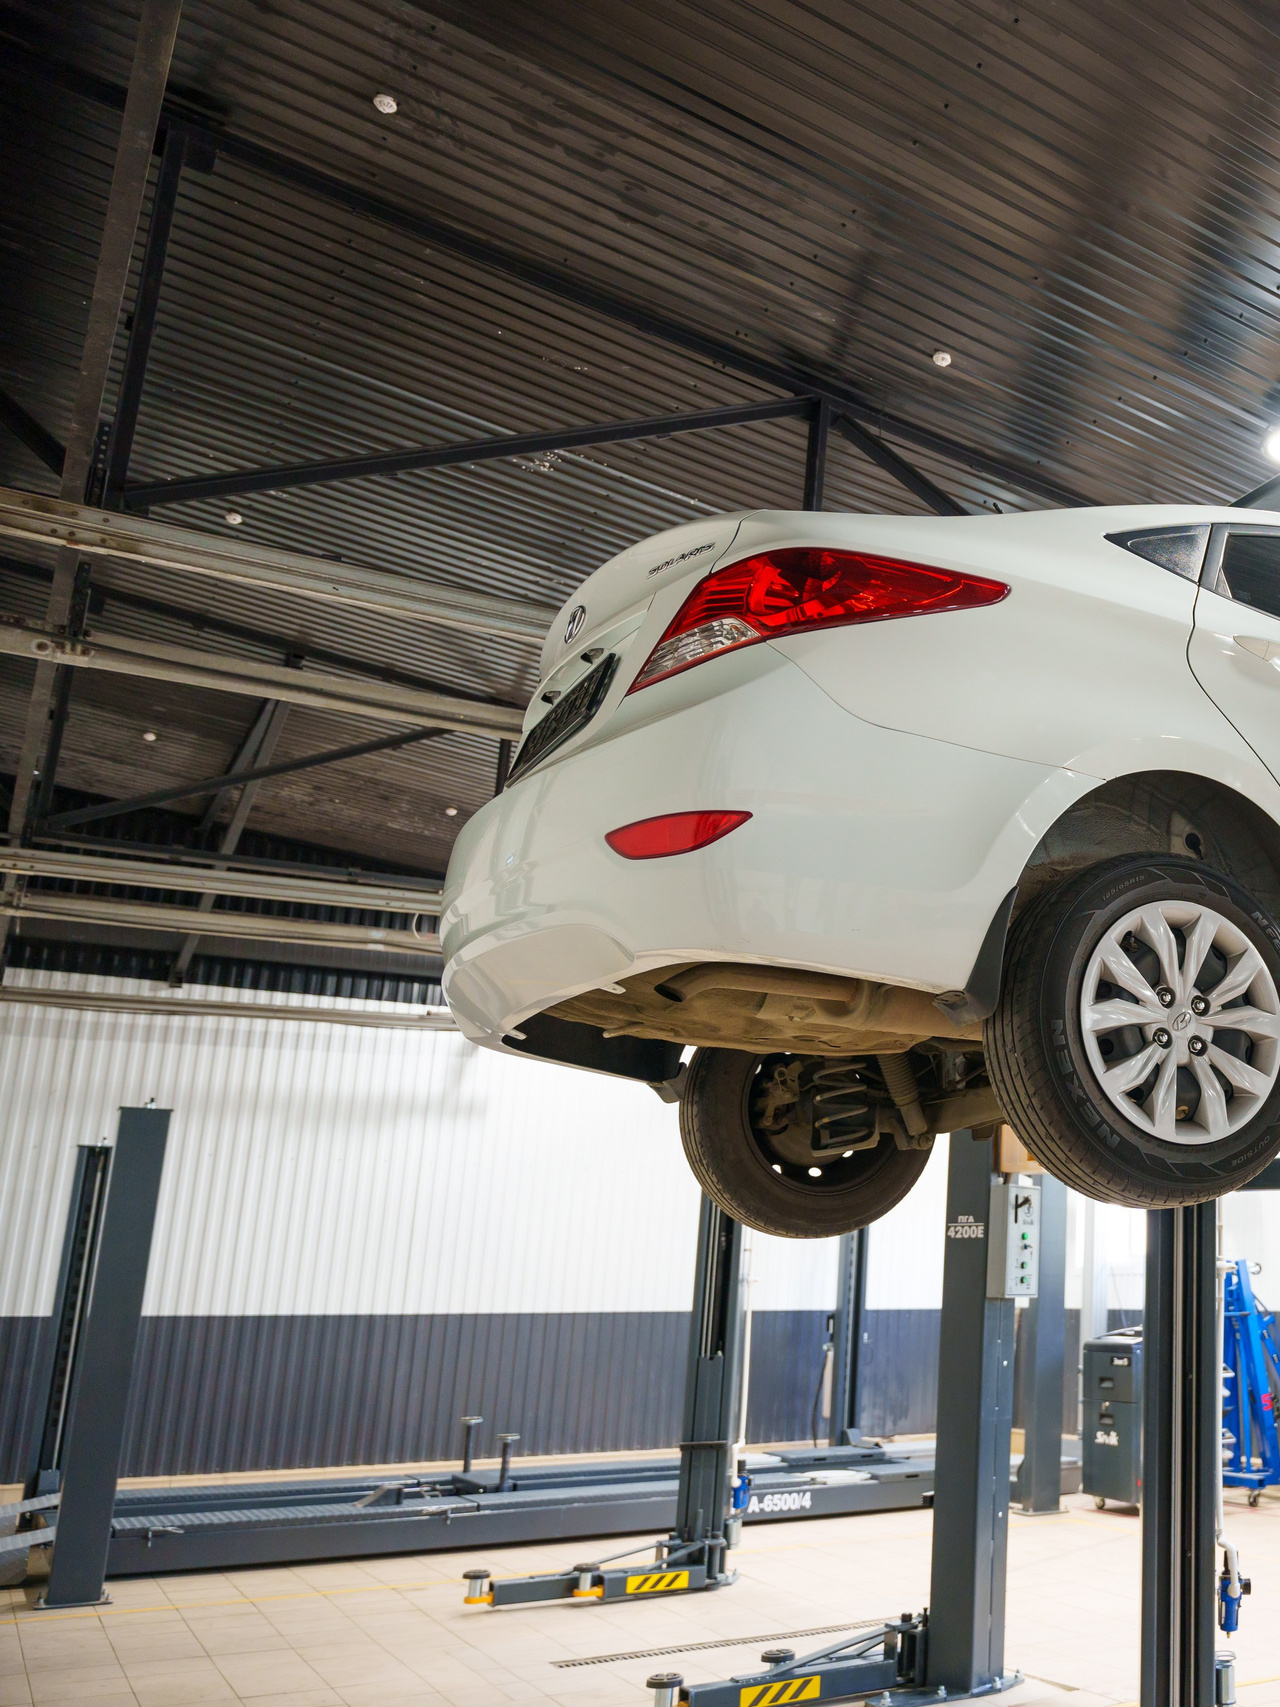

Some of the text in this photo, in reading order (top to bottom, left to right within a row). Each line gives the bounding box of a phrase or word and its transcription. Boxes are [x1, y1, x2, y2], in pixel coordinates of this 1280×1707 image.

[647, 542, 716, 579] SOLARIS
[1050, 1019, 1121, 1150] NEXEN
[1230, 1135, 1271, 1168] OUTSIDE
[947, 1226, 985, 1238] 4200E
[1261, 1393, 1273, 1411] 5
[730, 1491, 812, 1514] A-6500/4
